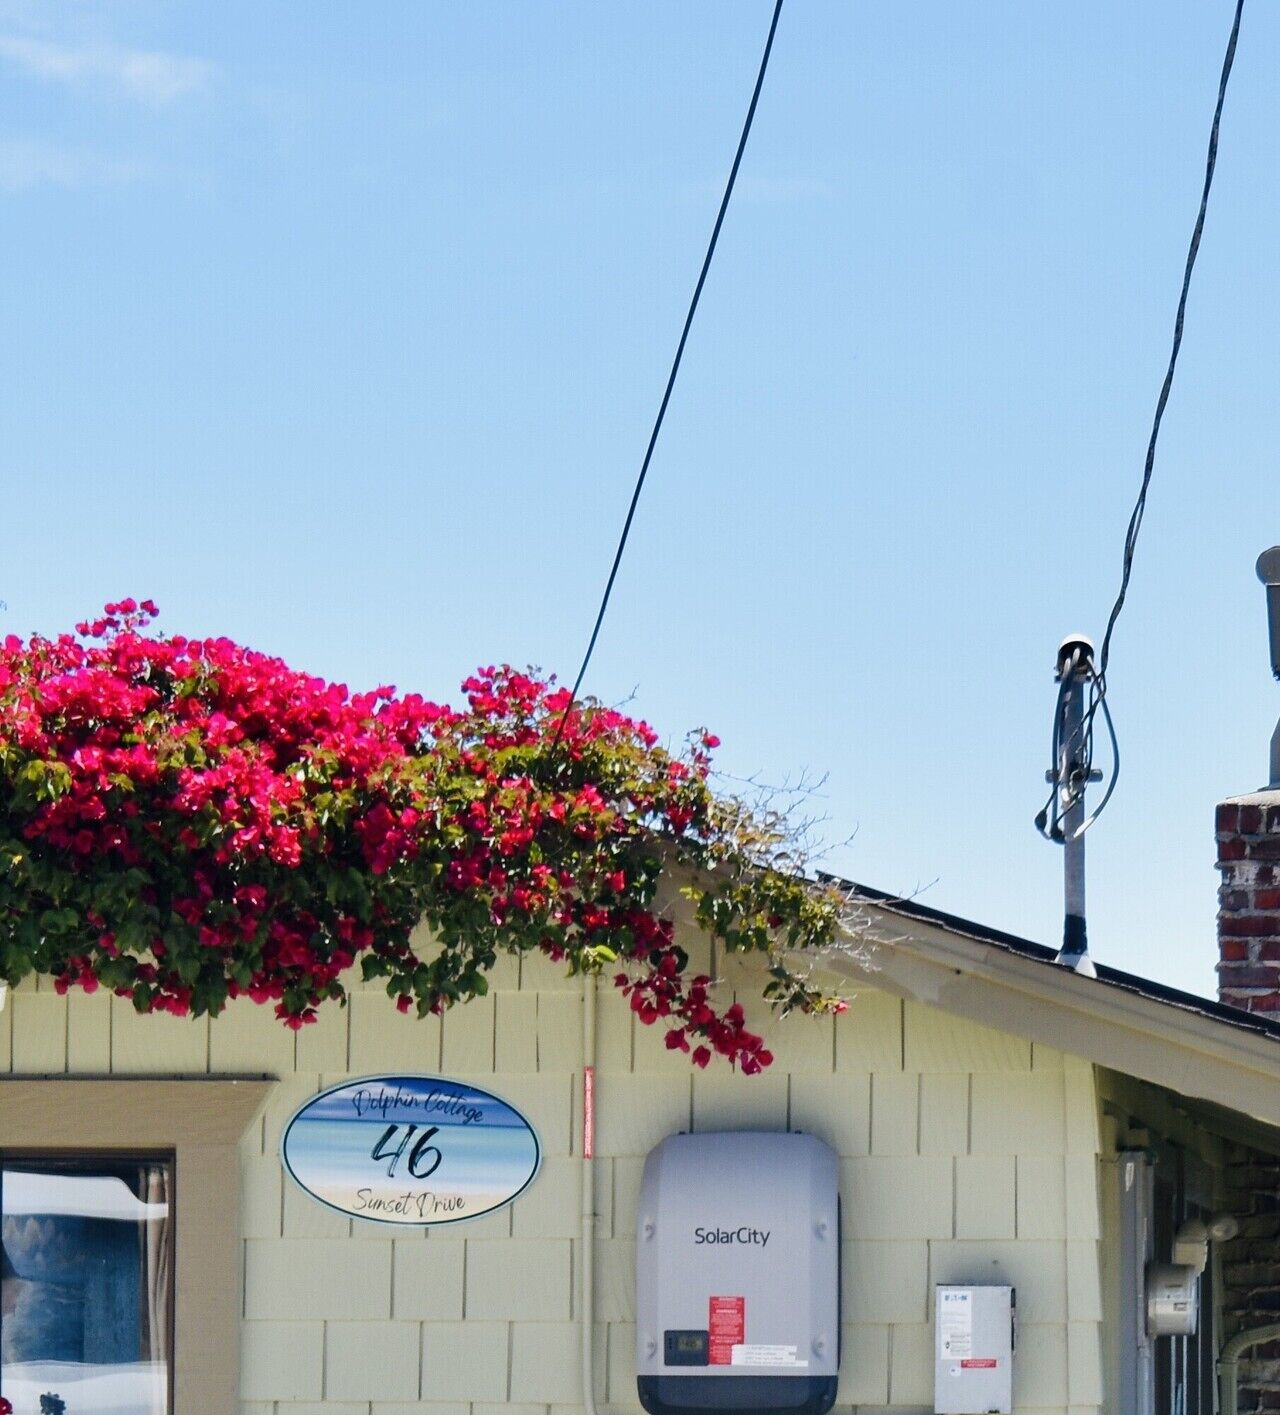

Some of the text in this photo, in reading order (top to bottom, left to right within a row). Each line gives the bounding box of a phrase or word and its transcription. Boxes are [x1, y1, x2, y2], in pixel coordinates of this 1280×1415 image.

[352, 1086, 483, 1125] Dolphin Cottage
[371, 1124, 442, 1179] 46
[353, 1188, 466, 1217] Sunset Drive
[694, 1227, 771, 1248] SolarCity
